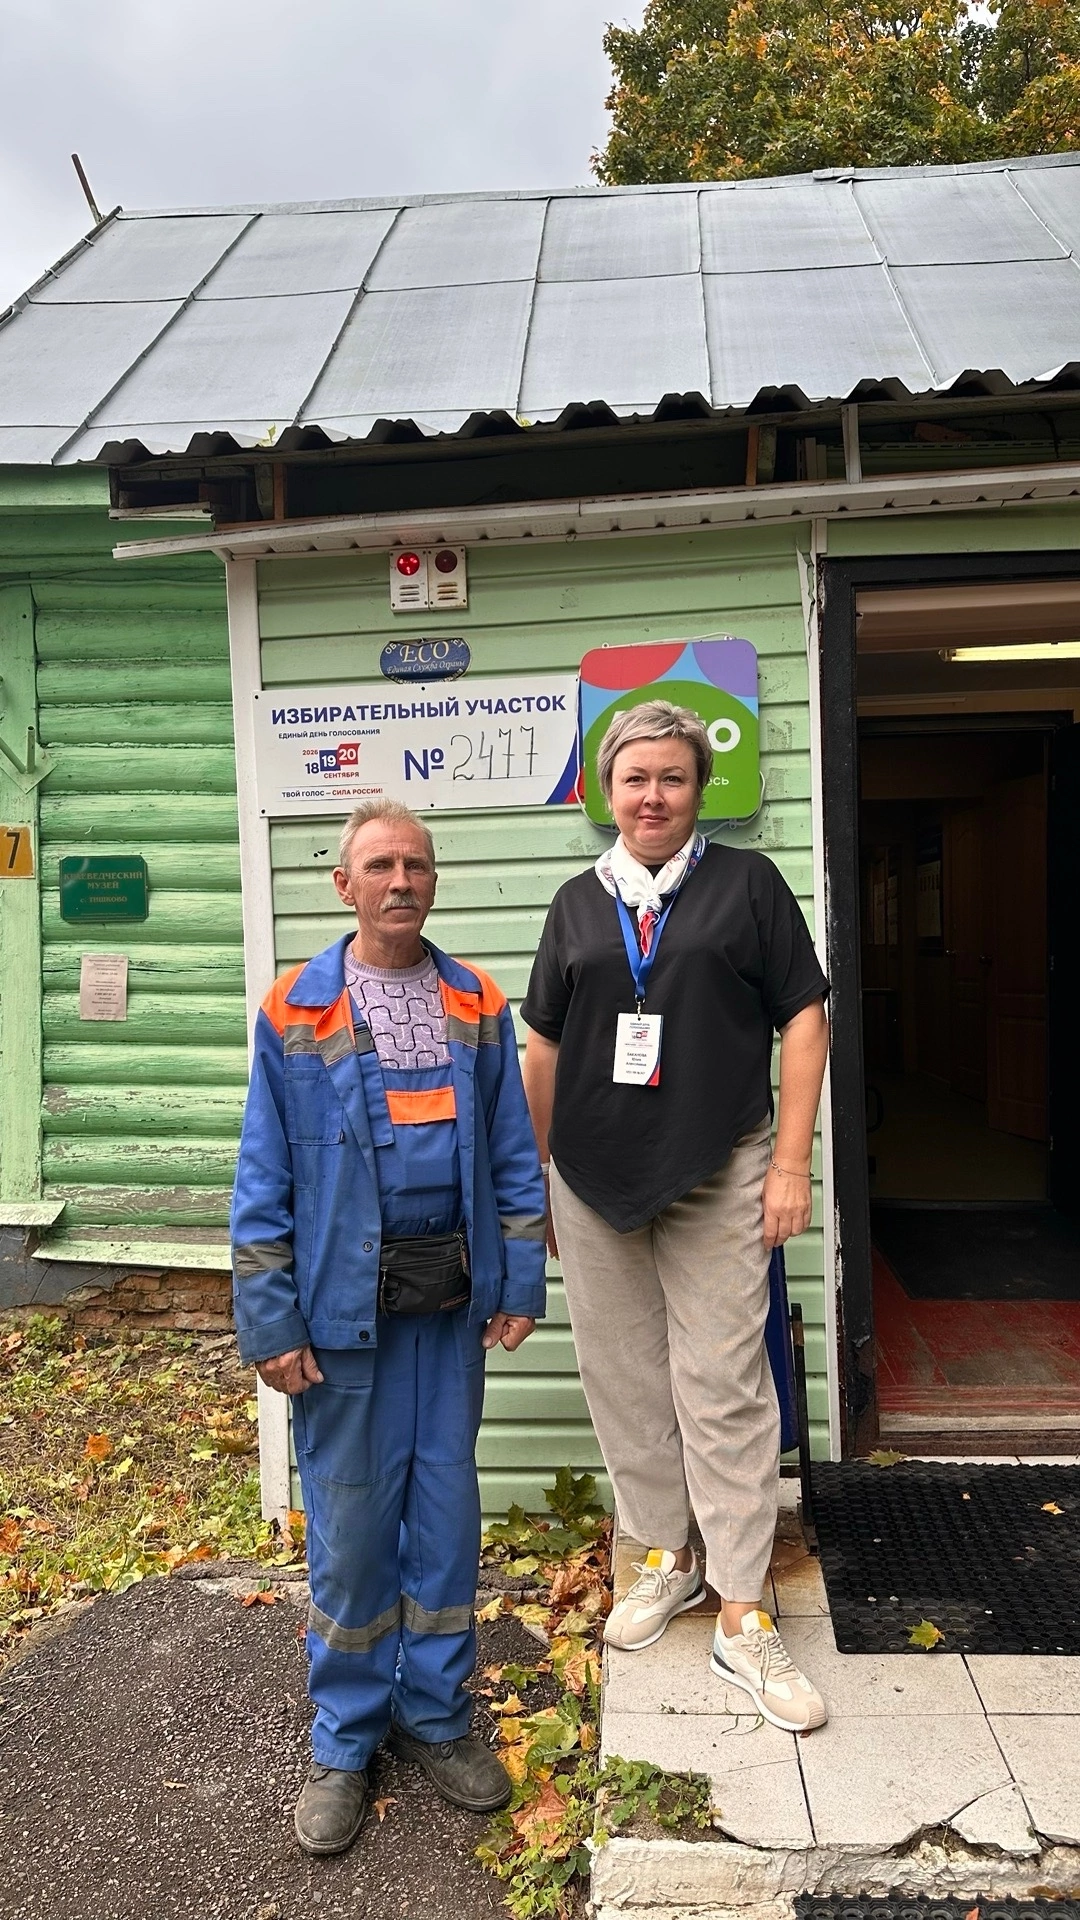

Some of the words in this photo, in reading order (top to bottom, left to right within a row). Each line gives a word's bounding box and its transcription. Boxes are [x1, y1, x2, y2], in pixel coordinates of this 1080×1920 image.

[272, 697, 459, 724] ИЗБИРАТЕЛЬНЫЙ
[465, 695, 566, 716] УЧАСТОК
[278, 731, 308, 739] ЕДИНЫЙ
[309, 731, 328, 739] ДЕНЬ
[329, 729, 381, 737] ГОЛОСОВАНИЯ
[404, 748, 445, 780] №
[451, 726, 538, 780] 2477
[305, 763, 319, 774] 18
[321, 755, 337, 767] 19
[339, 748, 357, 761] 20
[323, 771, 360, 779] СЕНТЯБРЯ
[282, 790, 301, 798] ТВОЙ
[332, 788, 351, 796] СИЛА
[6, 831, 20, 868] 7
[63, 871, 143, 880] КЕВЕДЧЕСКИЙ
[87, 881, 119, 889] МУЗЕЙ
